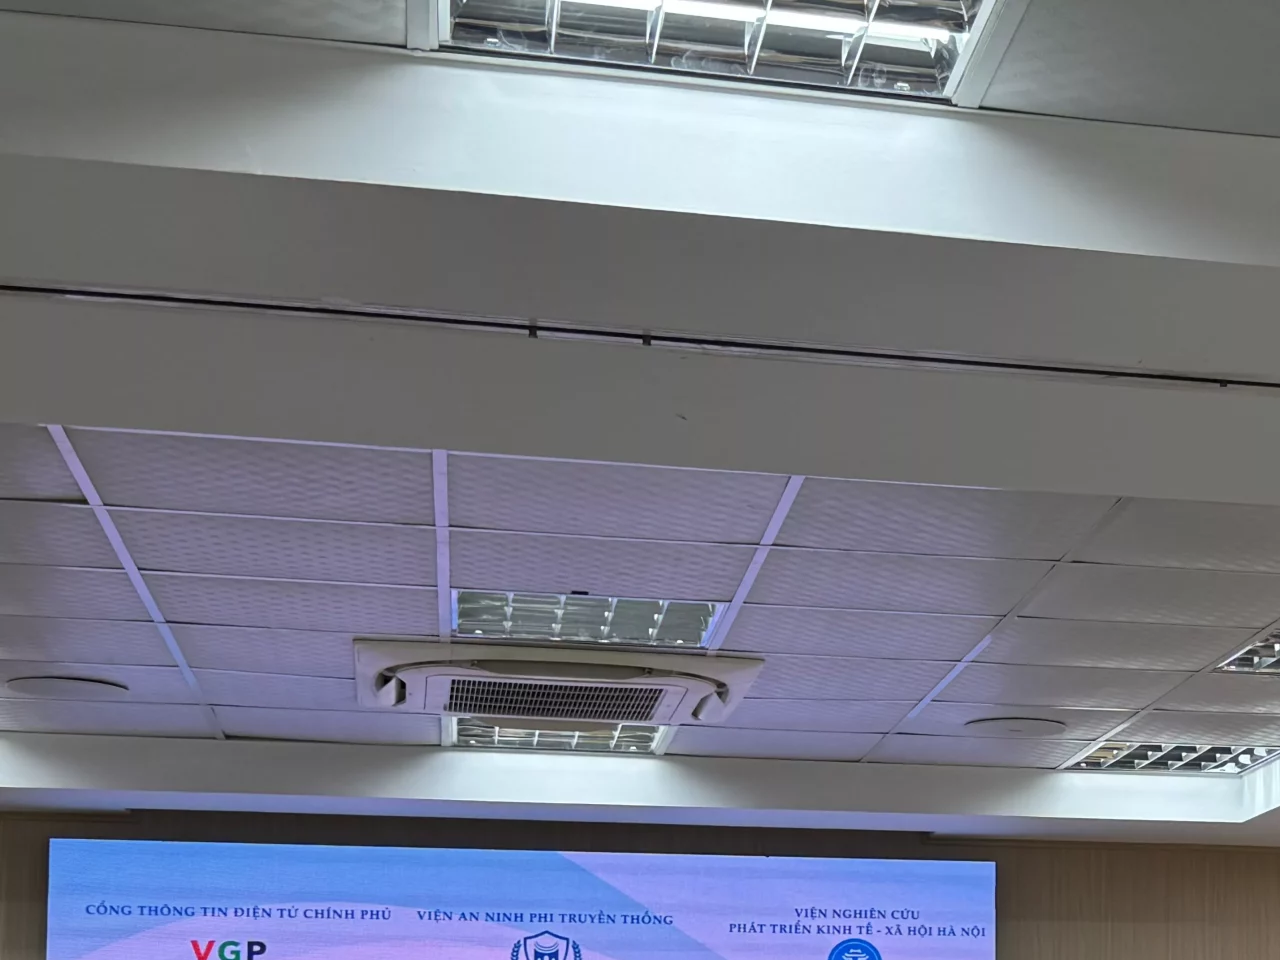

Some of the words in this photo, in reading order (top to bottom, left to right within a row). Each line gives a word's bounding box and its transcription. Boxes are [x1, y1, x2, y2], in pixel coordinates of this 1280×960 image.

[86, 900, 132, 916] CỔNG
[138, 902, 195, 917] THÔNG
[200, 906, 229, 917] TIN
[234, 905, 272, 921] ĐIỆN
[277, 904, 299, 919] TỬ
[304, 903, 355, 920] CHÍNH
[361, 905, 392, 921] PHỦ
[417, 908, 454, 923] VIỆN
[459, 911, 480, 922] AN
[485, 912, 524, 923] NINH
[530, 912, 554, 923] PHI
[559, 909, 617, 924] TRUYỀN
[621, 909, 674, 925] THỐNG
[795, 907, 828, 922] VIỆN
[833, 907, 887, 921] NGHIÊN
[891, 907, 920, 920] CỨU
[729, 922, 767, 935] PHÁT
[770, 919, 812, 935] TRIỂN
[817, 923, 853, 936] KINH
[857, 920, 873, 936] TẾ
[885, 922, 903, 937] XÃ
[908, 922, 933, 938] HỘI
[938, 923, 957, 937] HÀ
[962, 923, 986, 940] NỘI
